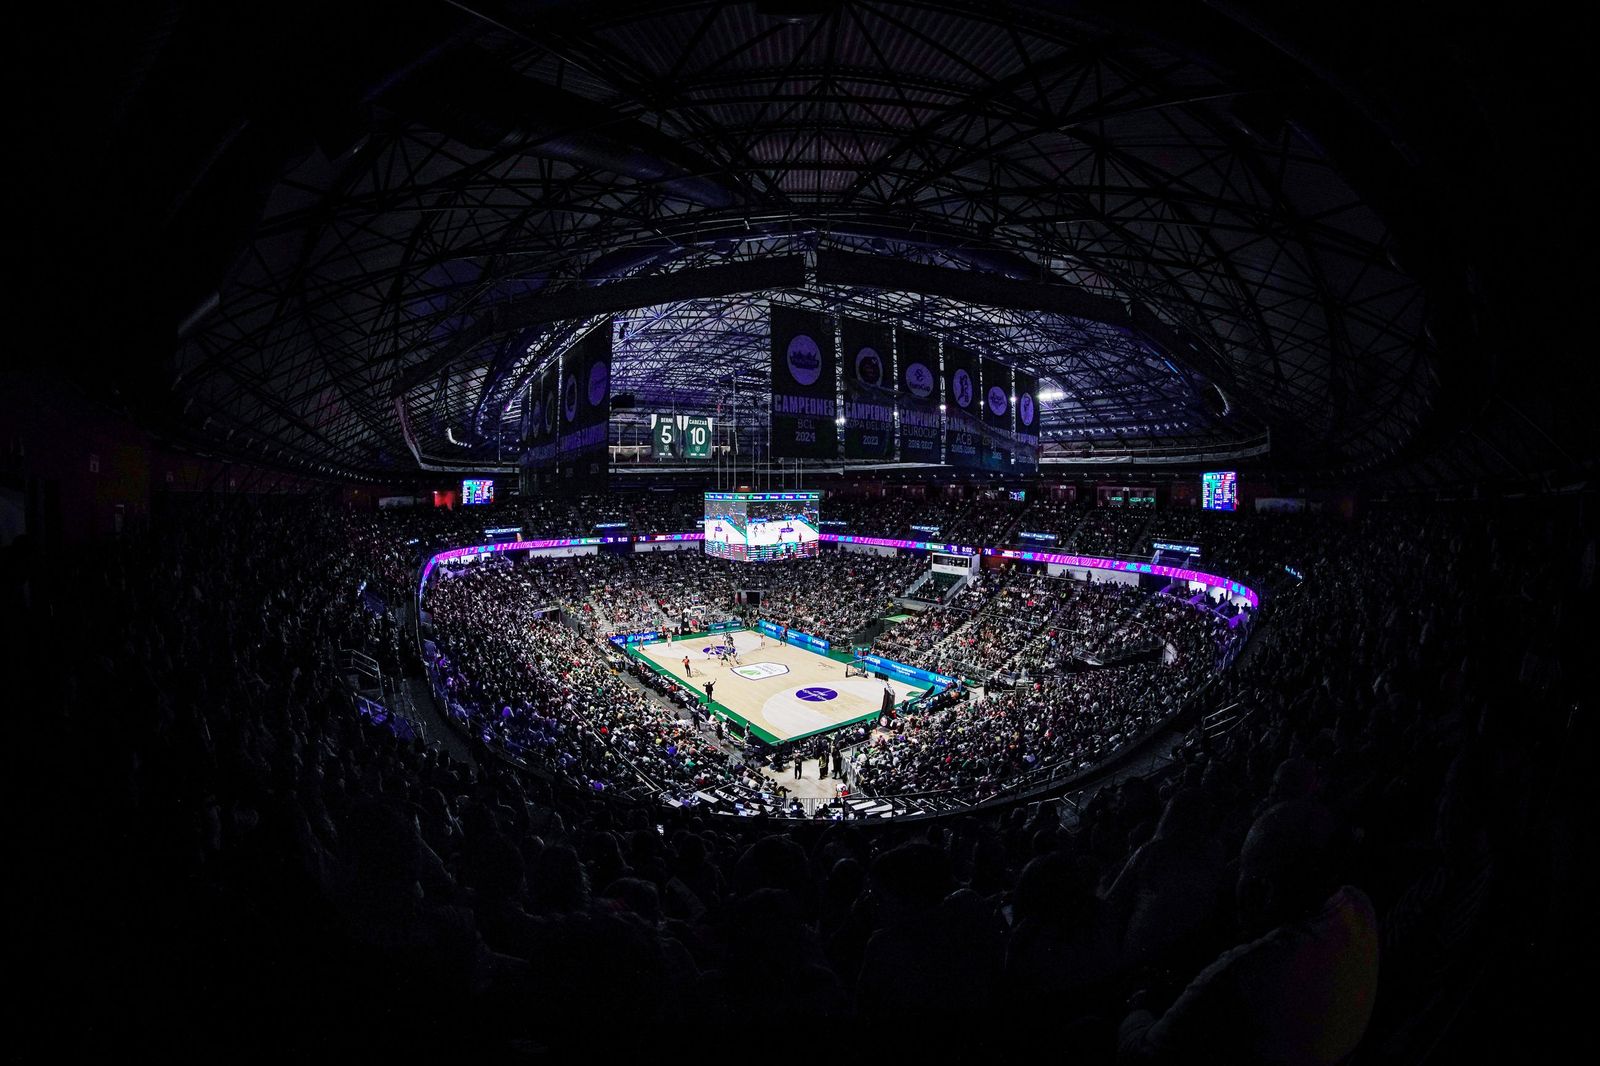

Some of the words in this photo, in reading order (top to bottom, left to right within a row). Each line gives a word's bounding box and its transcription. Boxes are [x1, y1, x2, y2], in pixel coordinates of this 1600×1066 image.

[774, 394, 834, 416] CAMPEONES
[845, 402, 892, 423] CAMPEONES
[797, 419, 815, 430] BCL
[661, 425, 672, 444] 5
[690, 427, 706, 445] 10
[794, 432, 815, 443] 2024
